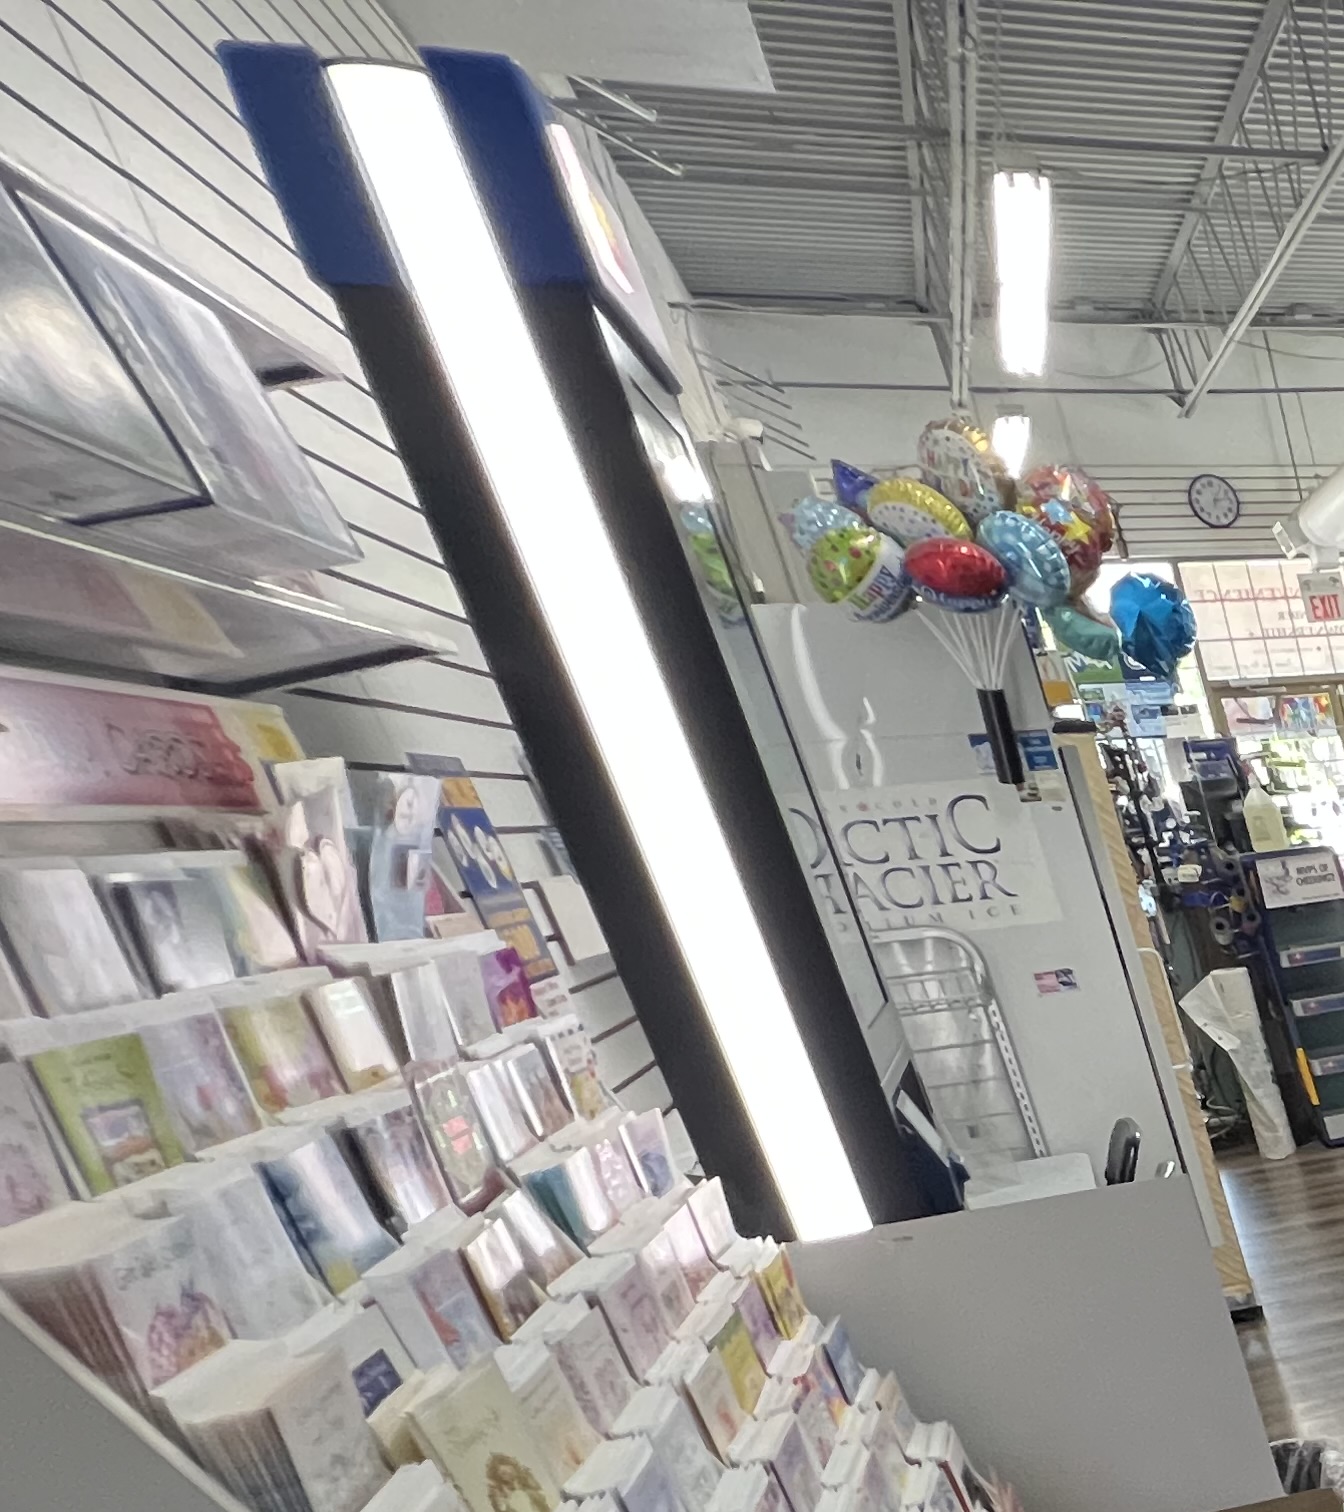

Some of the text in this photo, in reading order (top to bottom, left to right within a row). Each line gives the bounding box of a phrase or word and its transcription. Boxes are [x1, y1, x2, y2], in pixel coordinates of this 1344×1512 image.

[1308, 594, 1342, 620] EXIT
[840, 794, 1001, 865] CTIC
[851, 860, 1020, 912] ACIER
